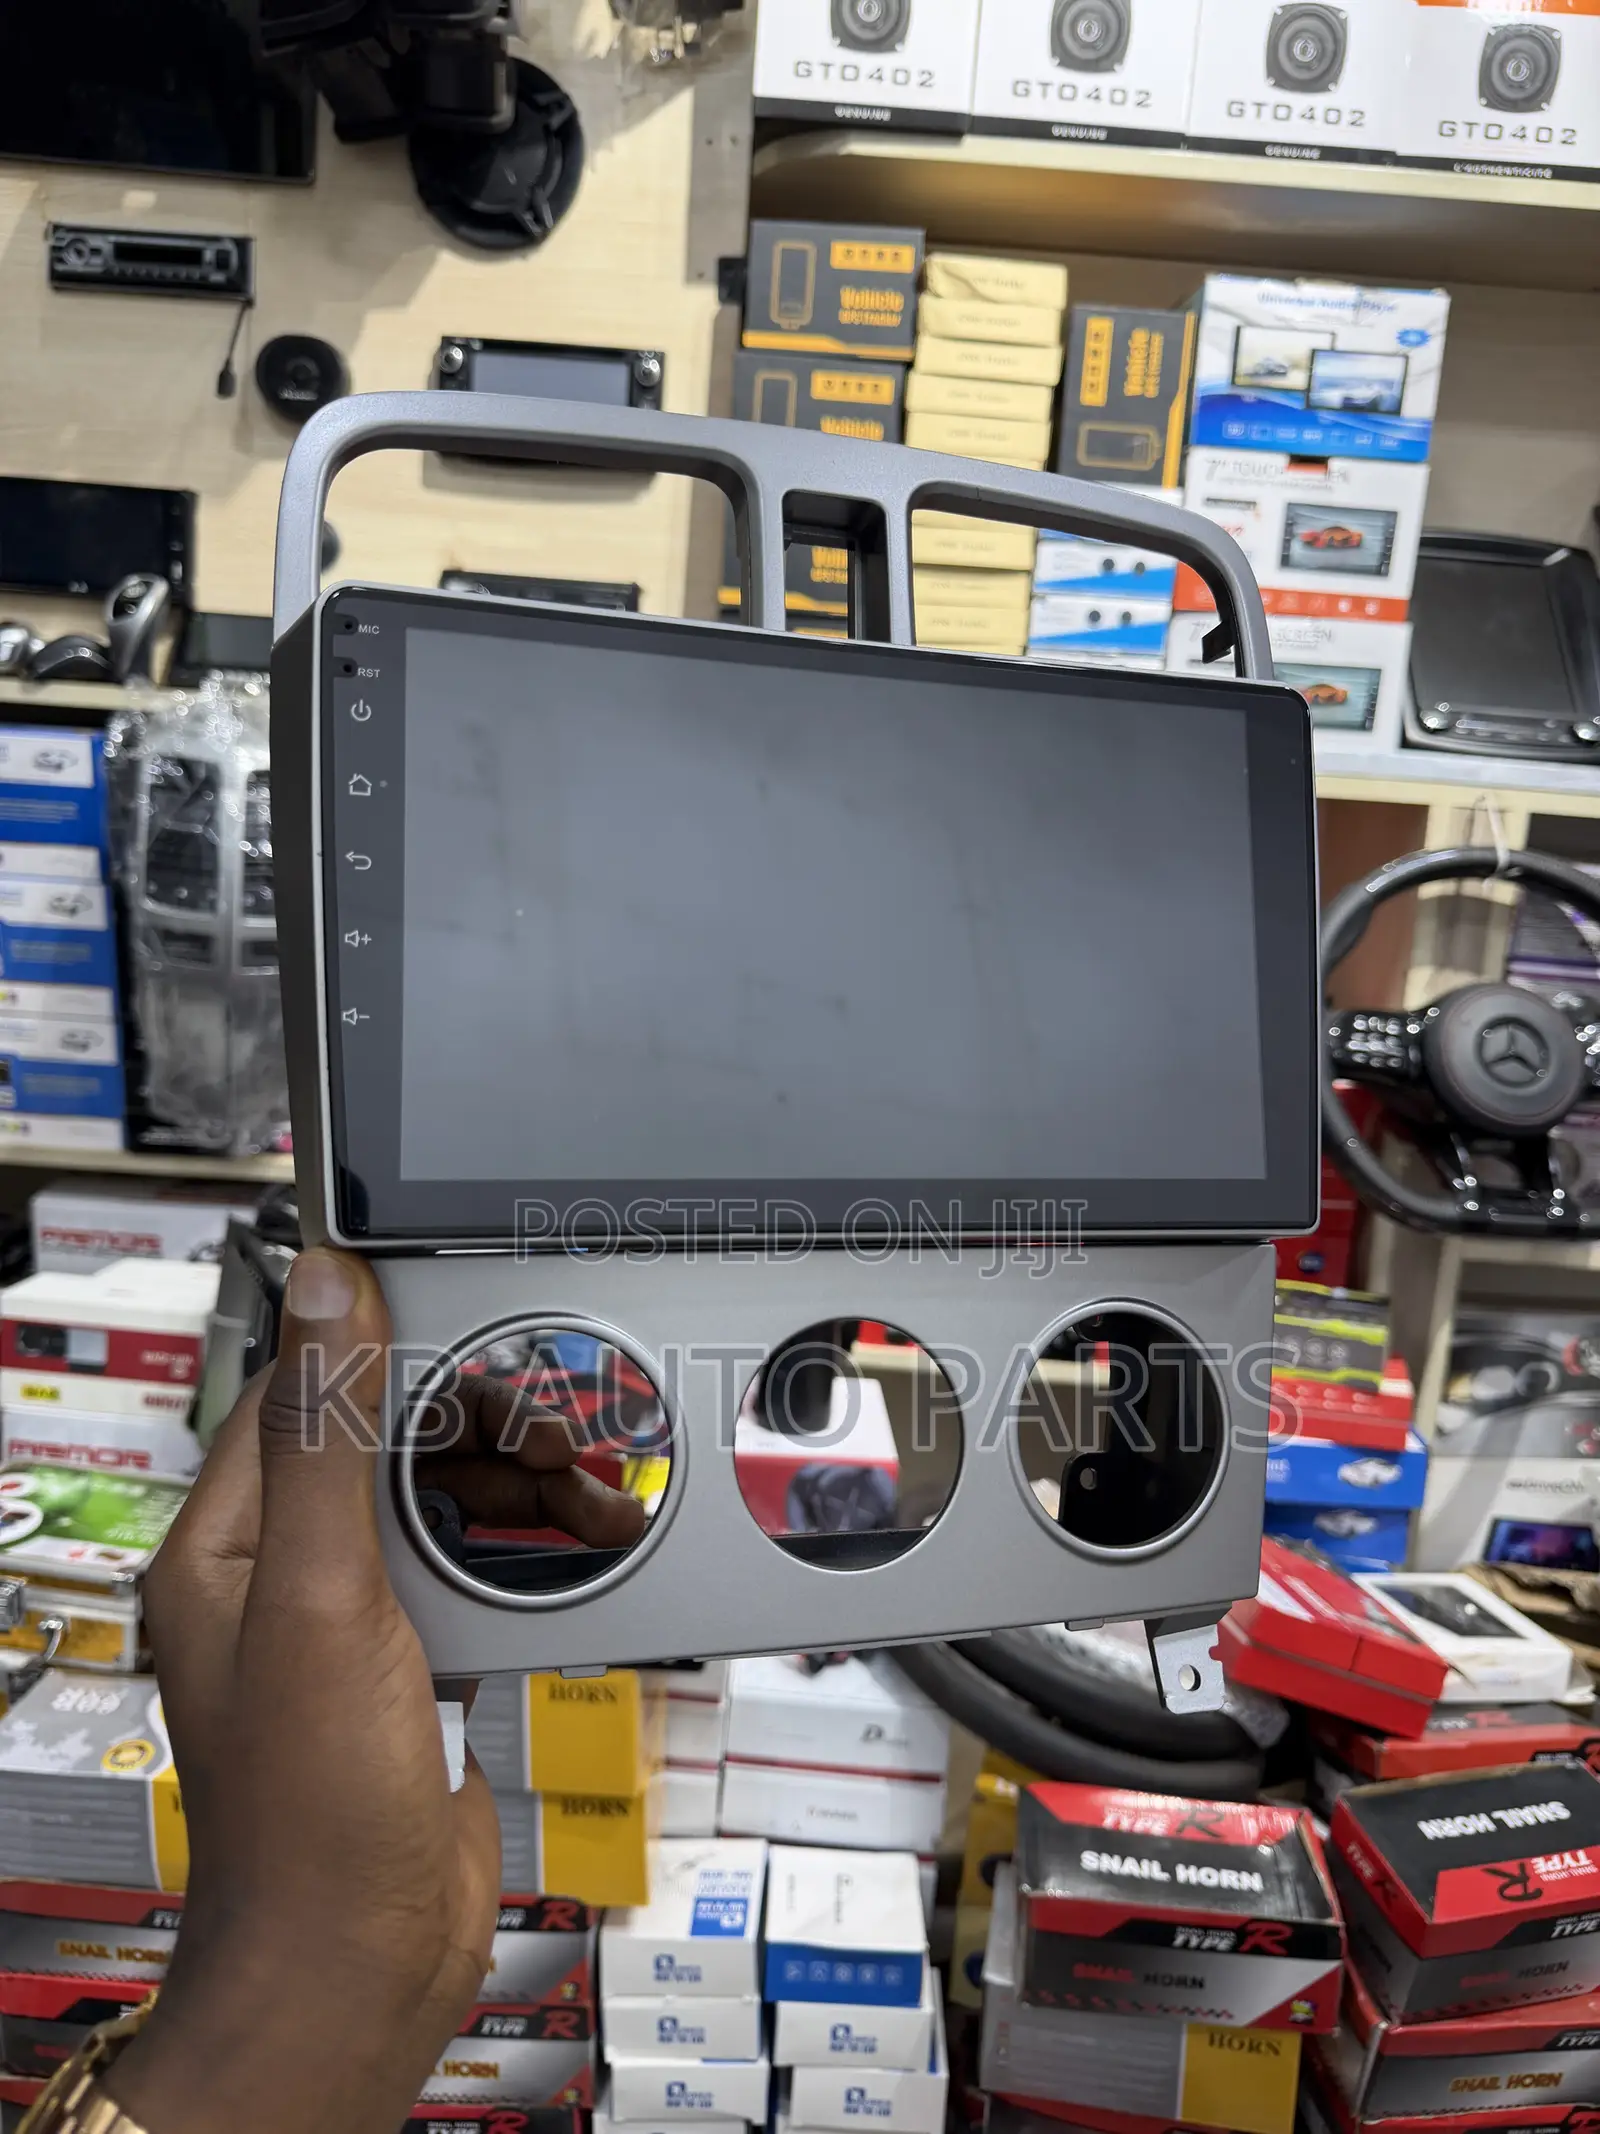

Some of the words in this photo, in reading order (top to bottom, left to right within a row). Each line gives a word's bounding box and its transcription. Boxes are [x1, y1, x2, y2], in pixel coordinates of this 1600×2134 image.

[793, 59, 936, 88] GTO402
[1011, 79, 1153, 108] GTO402
[1226, 99, 1367, 127] GTO402
[1438, 119, 1578, 146] GTO402
[358, 623, 380, 635] MIC
[357, 667, 381, 678] RST
[548, 1682, 618, 1704] HORN
[561, 1796, 630, 1818] HORN
[1491, 1800, 1572, 1829] SNAIL
[1175, 1808, 1225, 1838] R
[1417, 1812, 1498, 1841] HORN
[1080, 1850, 1171, 1883] SNAIL
[1175, 1863, 1264, 1894] HORN
[1530, 1850, 1595, 1875] TYPE
[1481, 1862, 1543, 1902] R
[539, 1901, 579, 1930] R
[1550, 1919, 1600, 1939] TYPE
[57, 1939, 113, 1960] SNAIL
[1172, 1931, 1238, 1951] TYPE
[1238, 1921, 1294, 1957] R
[1142, 1971, 1206, 1990] HORN
[542, 2010, 580, 2038] R
[1207, 2031, 1282, 2057] HORN
[443, 2059, 500, 2080] HORN
[1449, 2075, 1502, 2094] SNAIL
[1506, 2071, 1566, 2091] HORN
